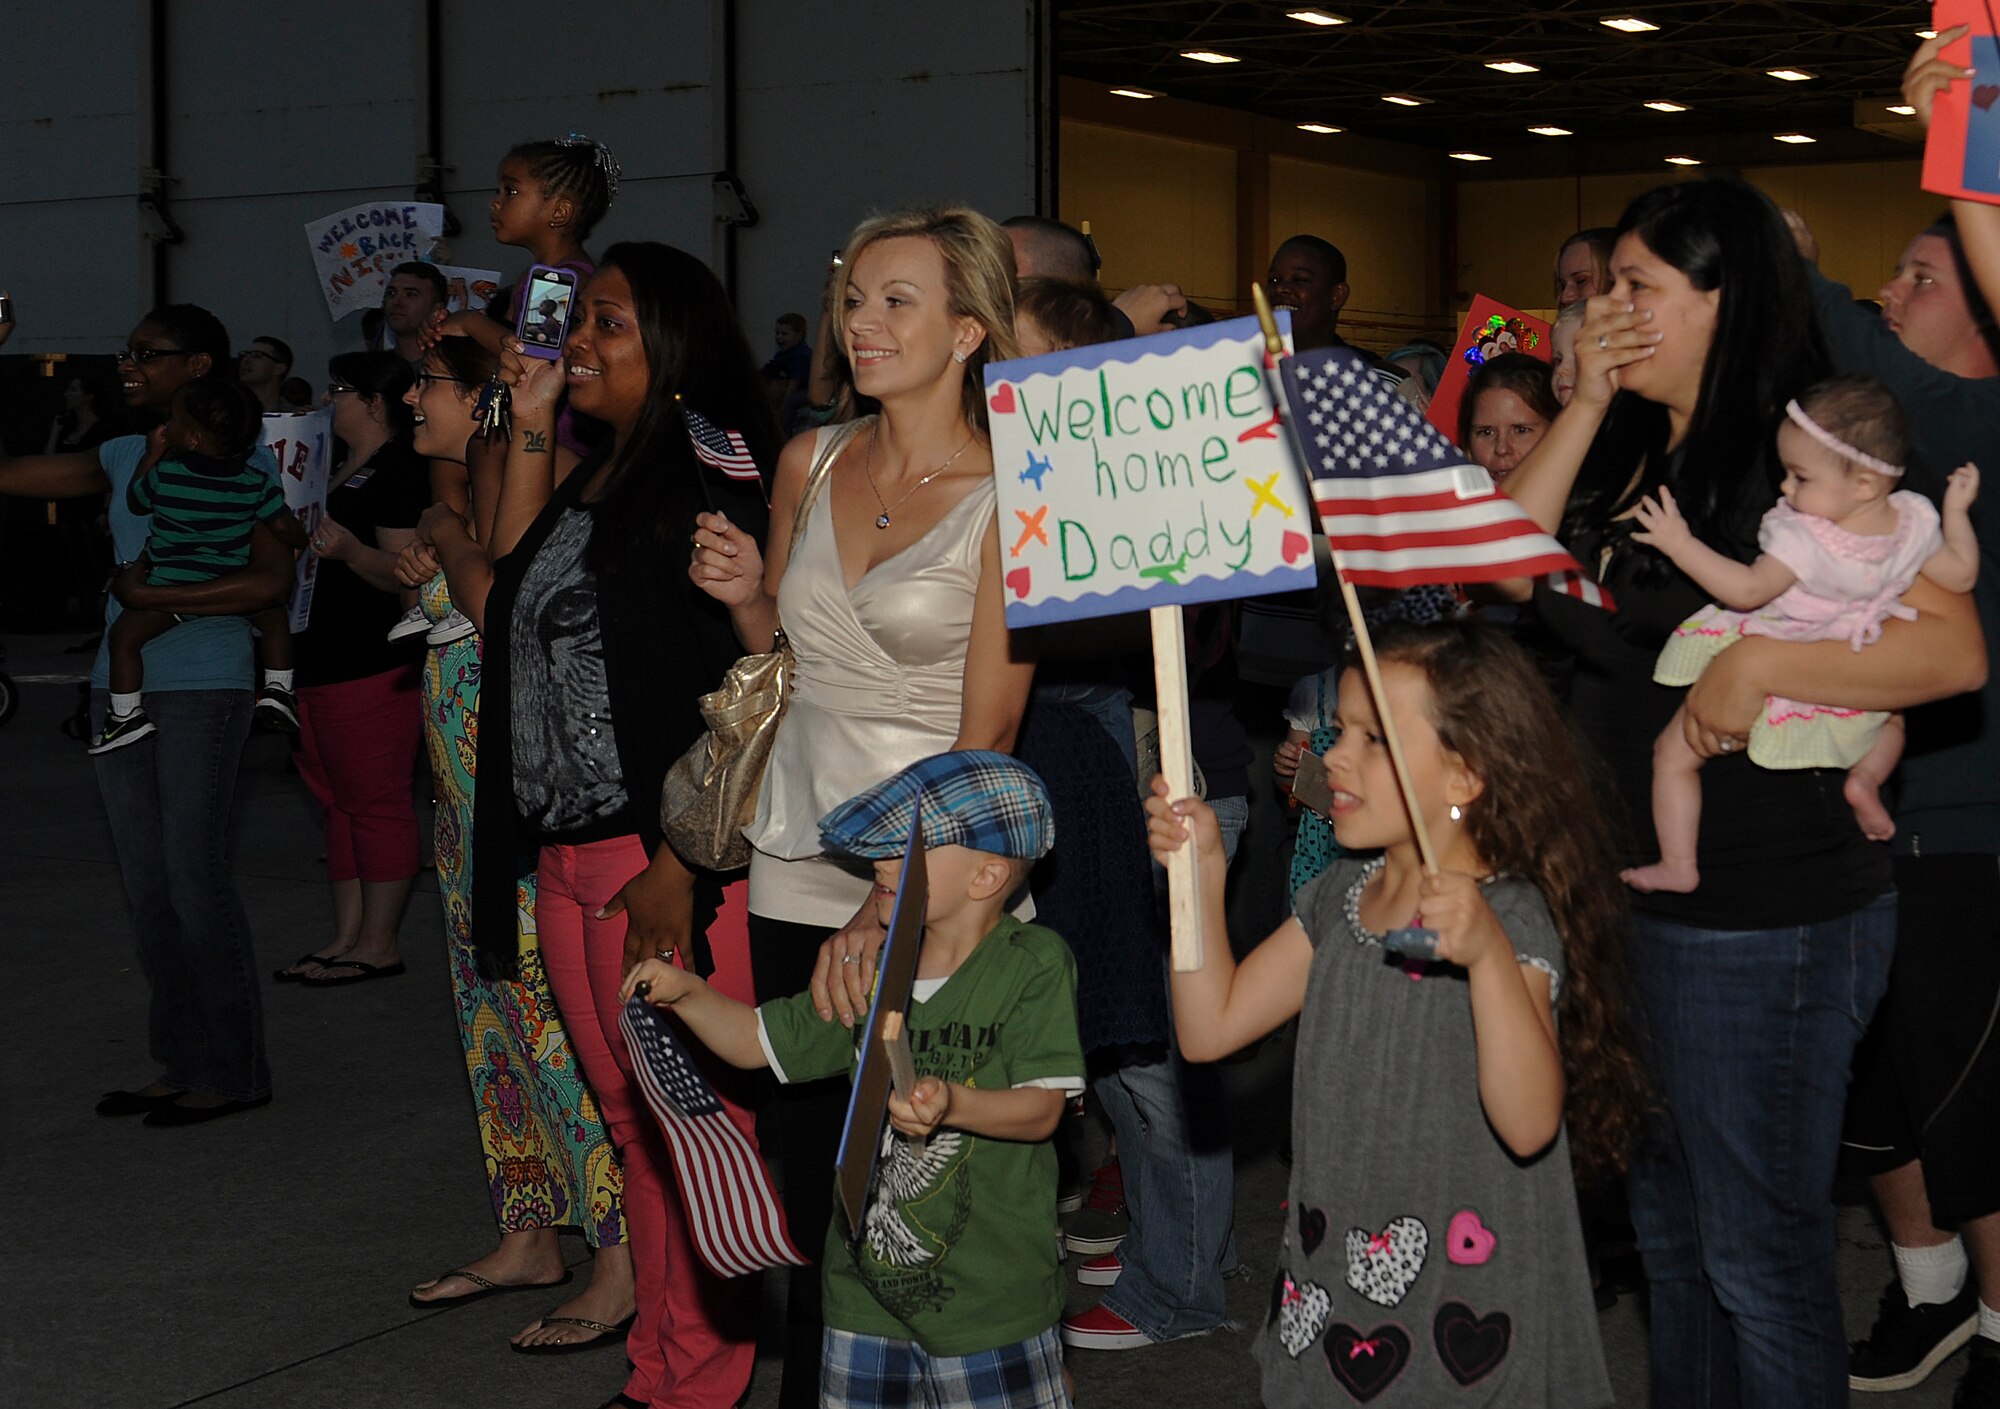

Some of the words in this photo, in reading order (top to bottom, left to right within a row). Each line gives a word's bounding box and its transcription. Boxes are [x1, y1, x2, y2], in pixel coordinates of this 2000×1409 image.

[318, 206, 417, 254] WELCOME
[358, 231, 417, 257] BACK
[1018, 364, 1263, 446] Welcome
[1092, 435, 1237, 500] home
[1057, 501, 1253, 581] Daddy
[880, 1278, 900, 1290] AND
[901, 1271, 932, 1288] POWER
